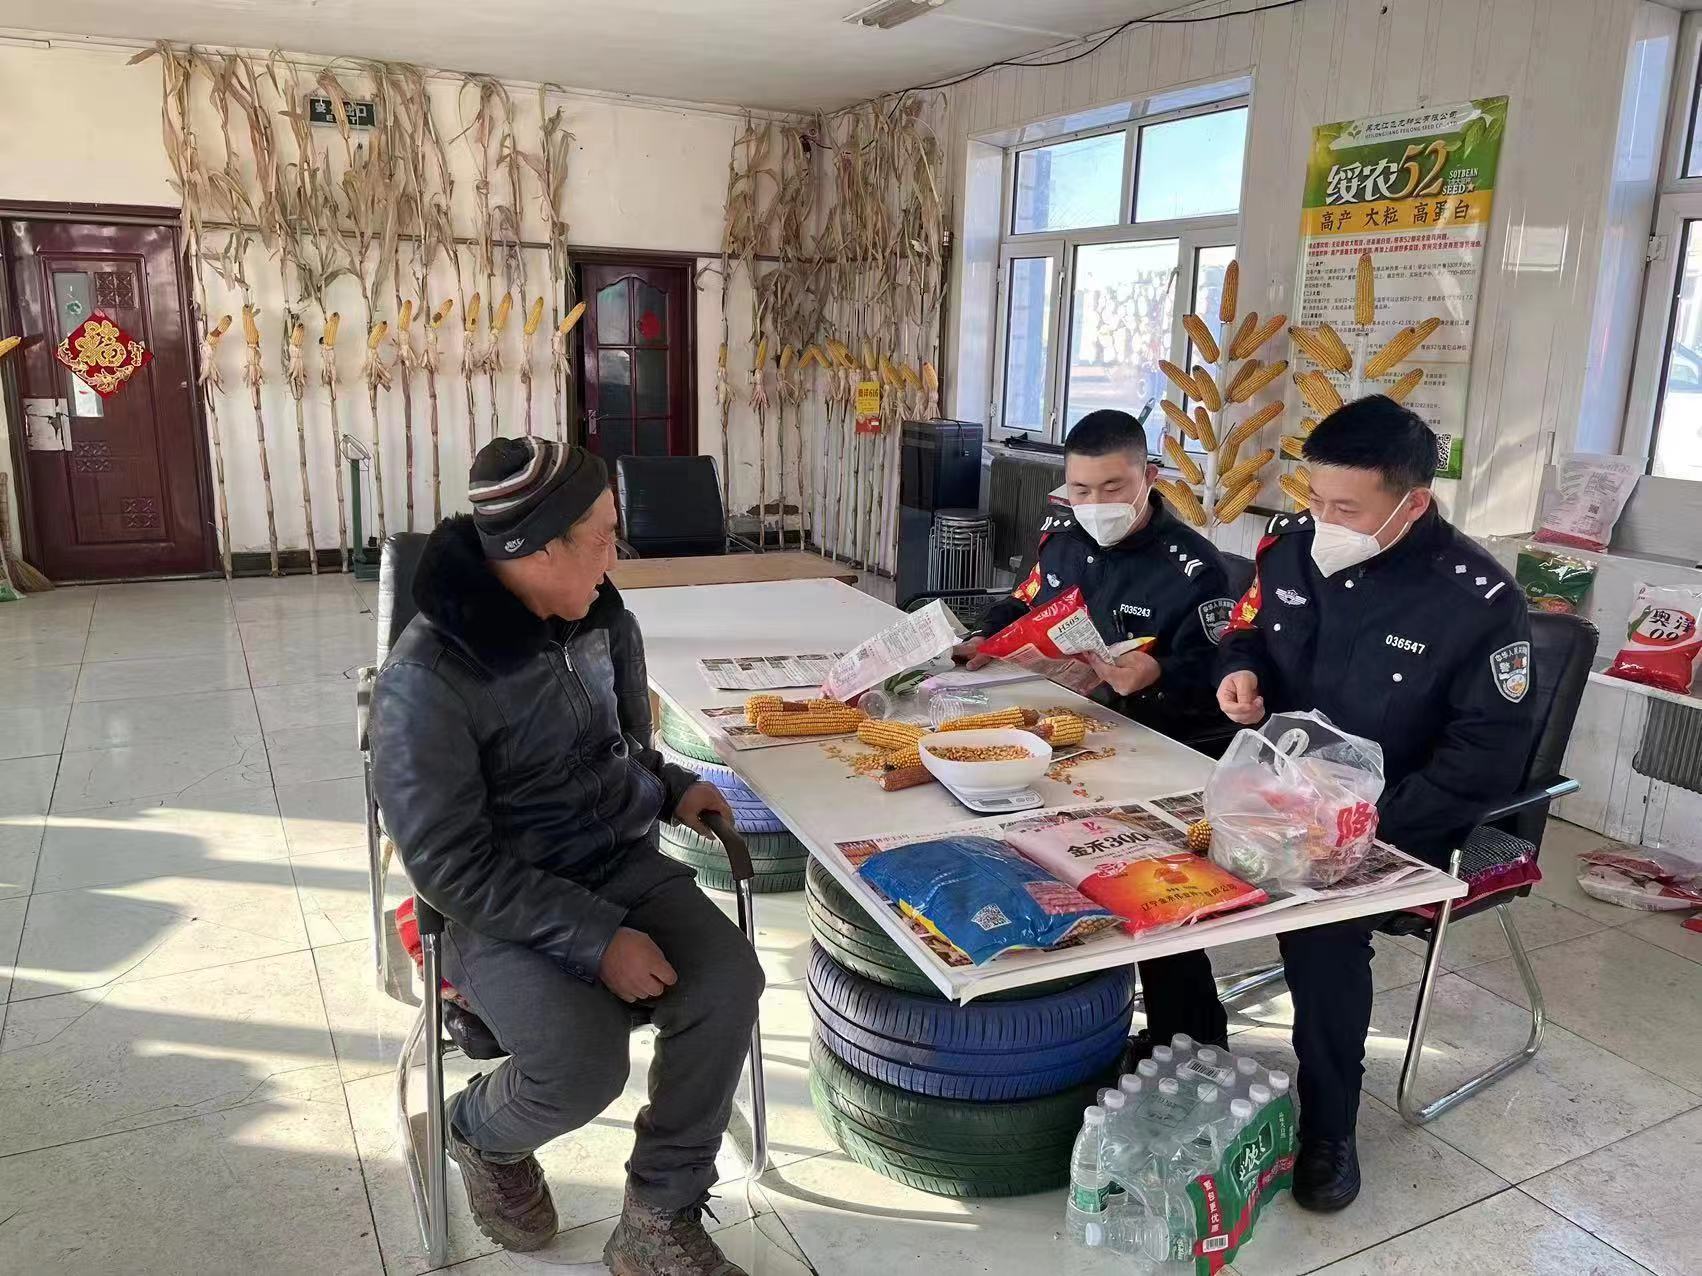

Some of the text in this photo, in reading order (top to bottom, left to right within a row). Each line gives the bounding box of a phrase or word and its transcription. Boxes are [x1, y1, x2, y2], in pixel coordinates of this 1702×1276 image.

[315, 102, 367, 117] 安出口
[1449, 167, 1479, 179] SOYBEAN
[1441, 184, 1466, 196] SEED
[1319, 199, 1471, 232] 高产 大粒 高蛋白
[1120, 603, 1151, 618] F035243
[1058, 615, 1080, 633] H505
[1649, 609, 1696, 633] 奥洋
[1385, 634, 1426, 655] 036547
